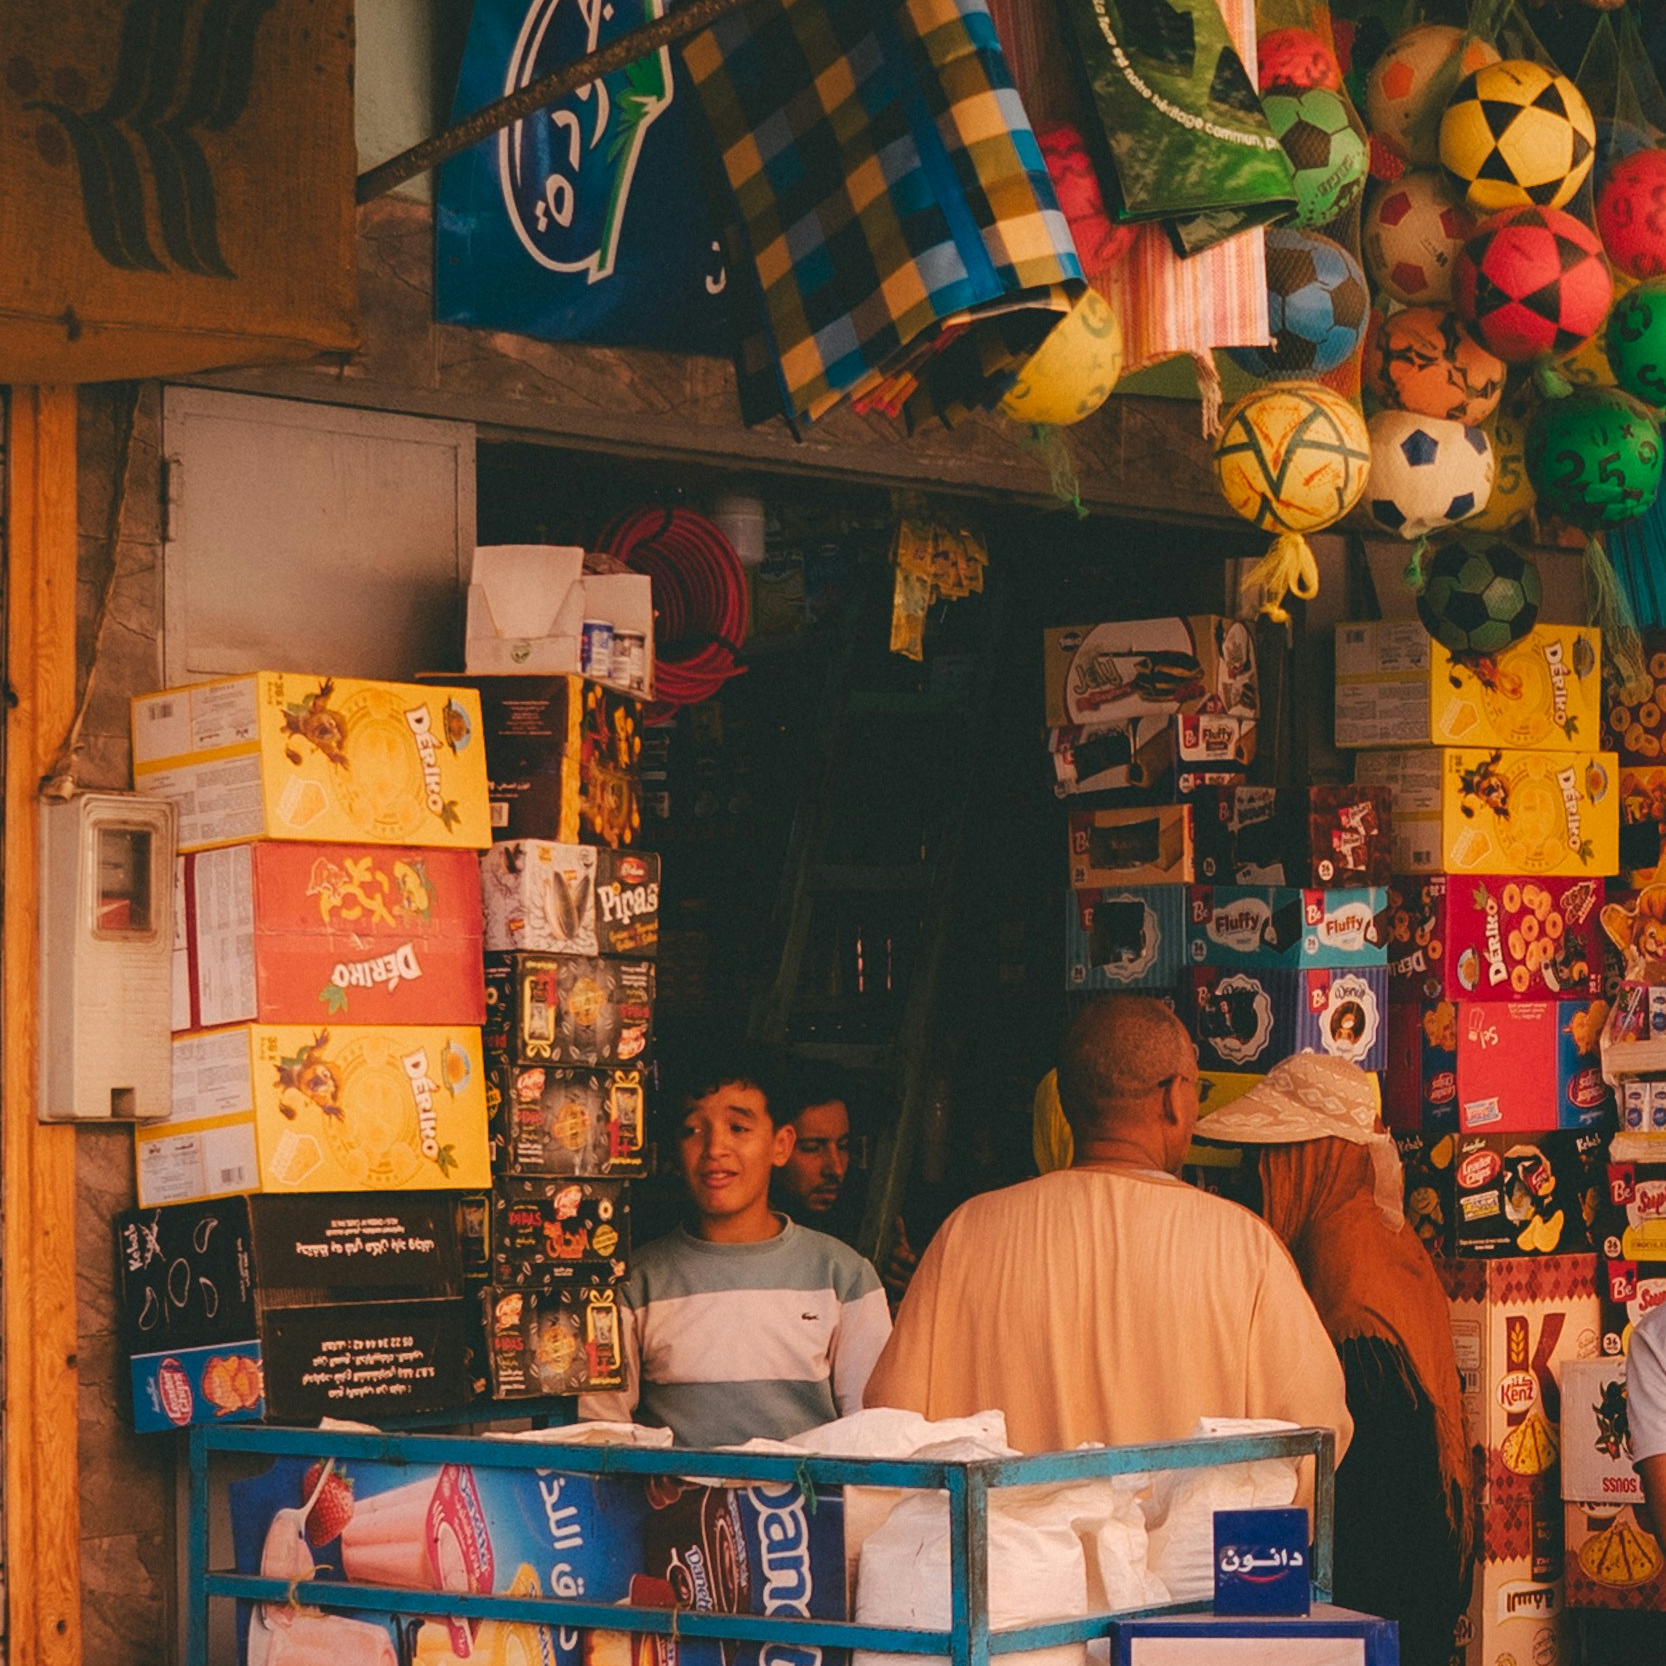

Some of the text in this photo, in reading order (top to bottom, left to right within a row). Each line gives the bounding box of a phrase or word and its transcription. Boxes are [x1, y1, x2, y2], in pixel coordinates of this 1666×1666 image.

[1124, 68, 1152, 98] notre
[1151, 94, 1204, 130] héritage
[1541, 639, 1571, 727] DÉRIKO
[403, 702, 443, 816] DÉRIKO
[1555, 766, 1584, 853] DÉRIKO
[597, 882, 660, 925] Pipas
[1192, 901, 1210, 923] Be
[1306, 904, 1323, 925] Be
[1215, 911, 1260, 934] Fluffy
[1325, 916, 1364, 936] Fluffy
[1481, 897, 1509, 985] DÉRIKO
[331, 942, 423, 993] DÉRIKO
[1388, 950, 1428, 978] DÉRI
[1312, 989, 1327, 1008] Be
[400, 1047, 441, 1162] DÉRIKO
[1611, 1179, 1633, 1203] Be
[508, 1211, 542, 1226] PIPAS
[122, 1223, 144, 1272] Kebab
[344, 1237, 363, 1257] في
[365, 1238, 389, 1258] مكان
[1607, 1239, 1619, 1250] 36
[1612, 1277, 1634, 1300] Be
[1606, 1336, 1618, 1347] 36
[1505, 1313, 1567, 1427] K
[1500, 1383, 1535, 1407] Kenz
[1603, 1477, 1637, 1494] SOUSS
[535, 1467, 584, 1549] اللذ
[1220, 1546, 1304, 1573] دانون
[1505, 1587, 1556, 1616] السفة
